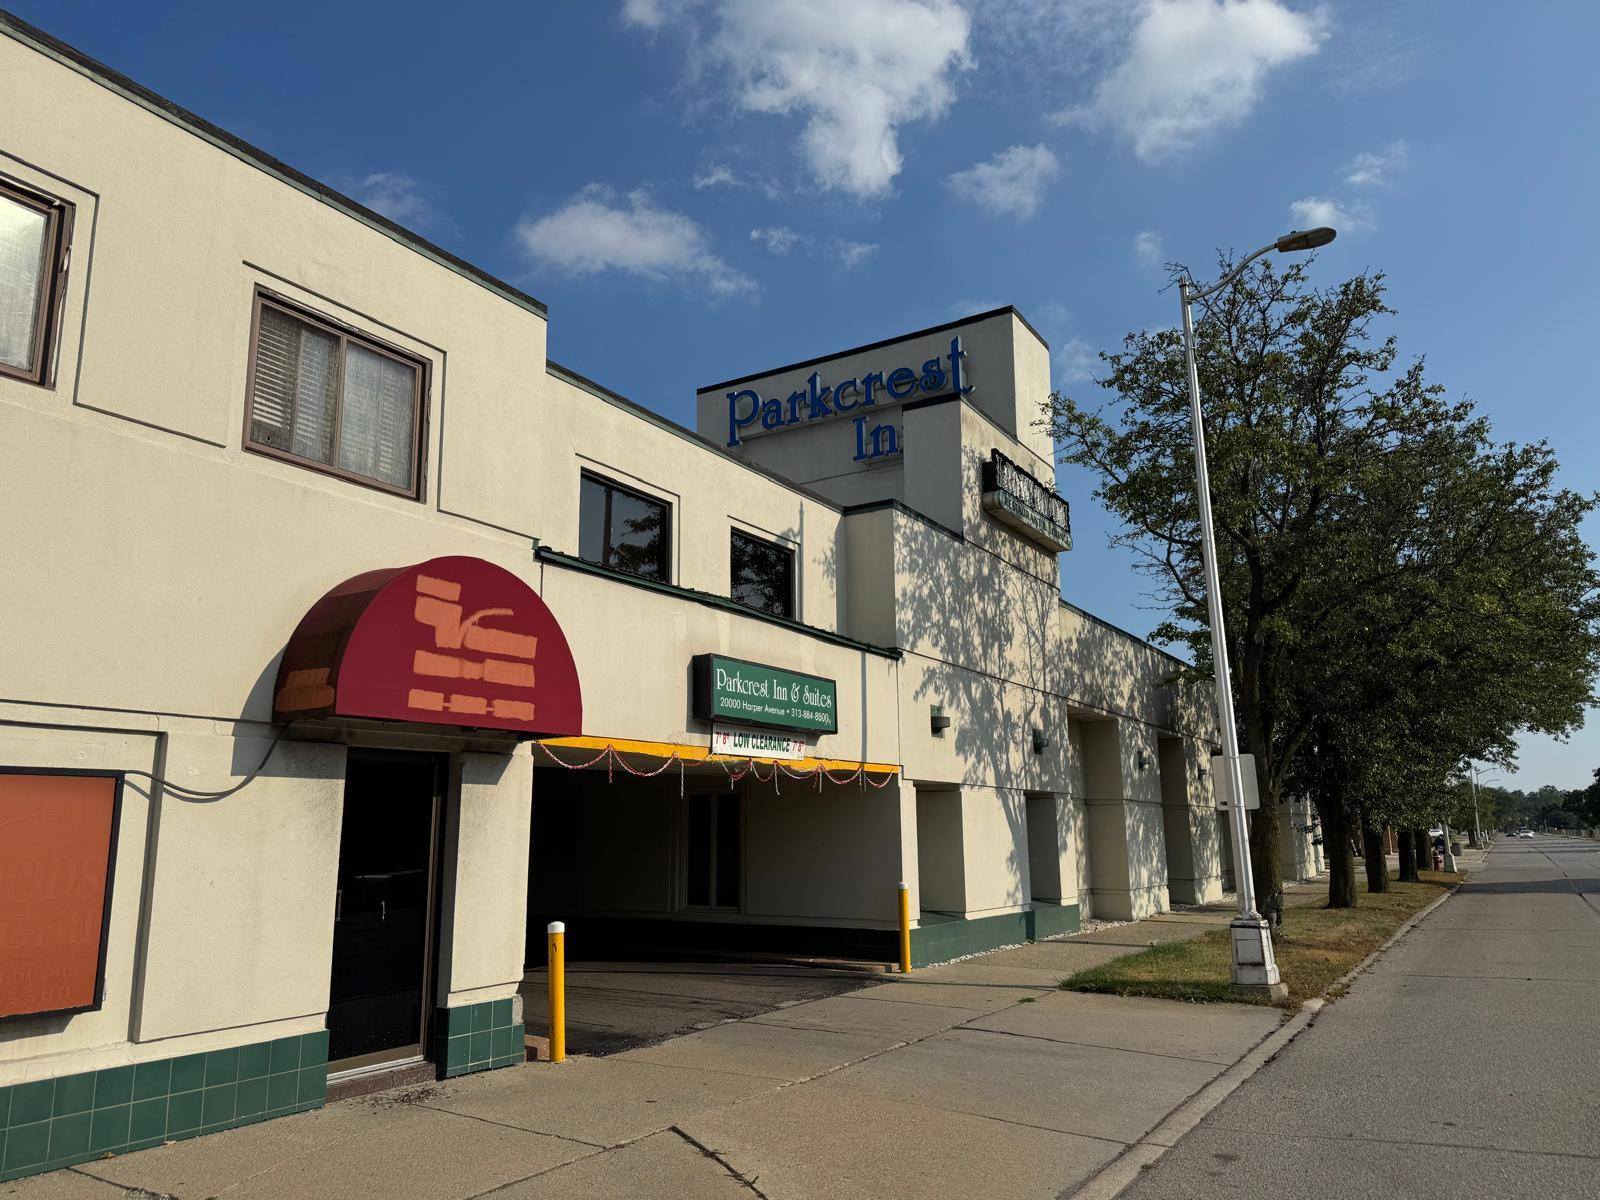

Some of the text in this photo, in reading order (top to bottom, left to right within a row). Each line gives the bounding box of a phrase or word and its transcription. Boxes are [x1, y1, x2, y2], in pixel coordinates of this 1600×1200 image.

[726, 335, 975, 448] Parkcrest
[853, 416, 903, 461] In
[716, 668, 832, 709] Parkcrest Inn & Suites
[720, 697, 741, 710] 20000
[742, 701, 764, 714] Harper
[764, 705, 785, 716] Avenue
[733, 732, 750, 748] LOW
[751, 733, 791, 753] CLEARANCE
